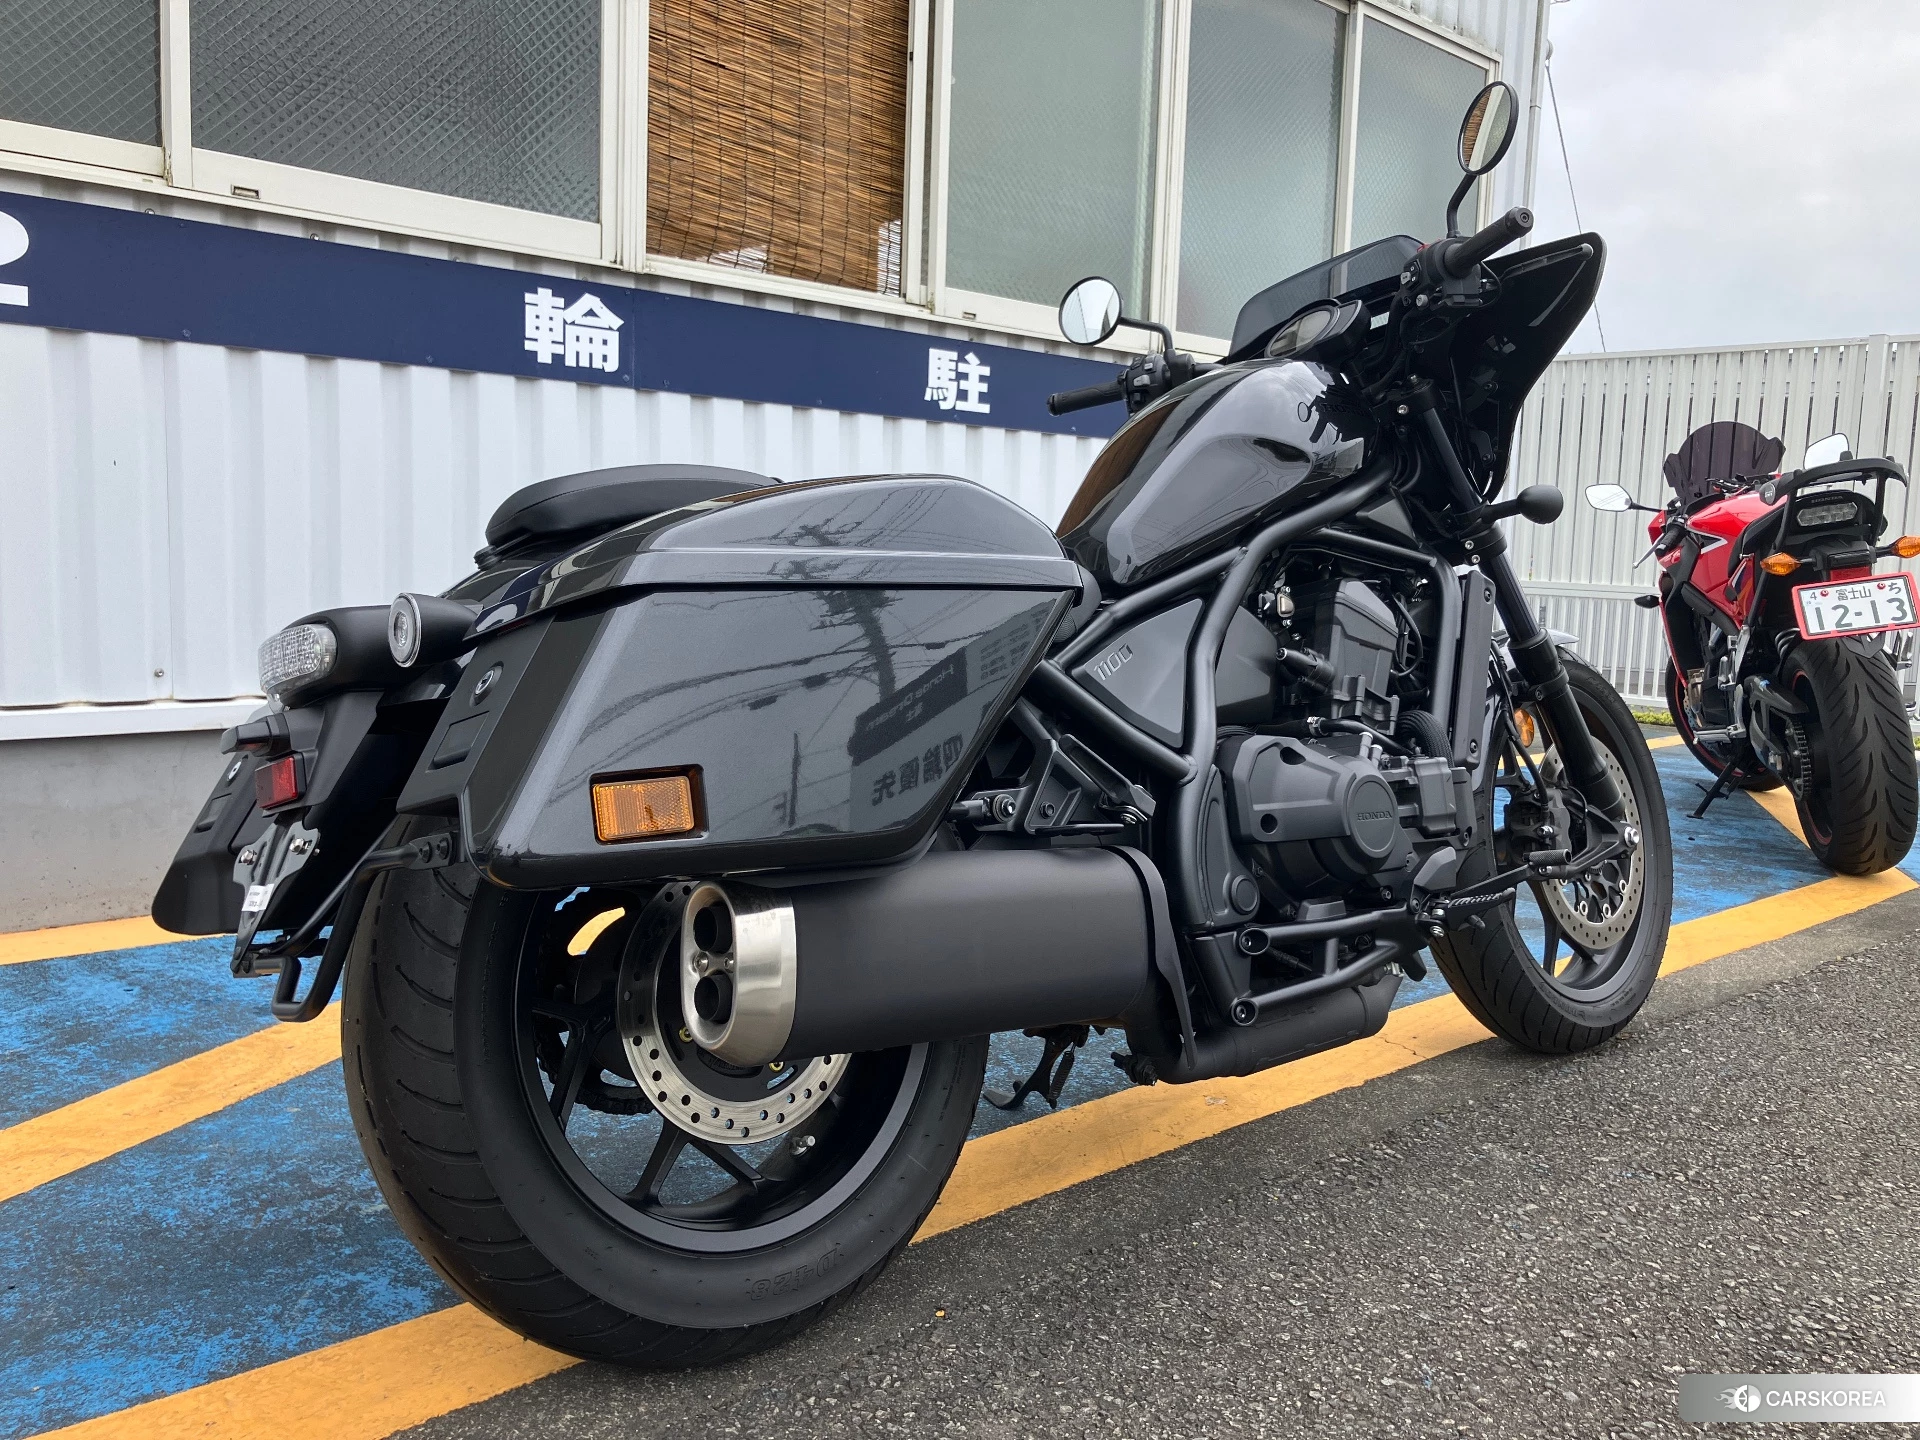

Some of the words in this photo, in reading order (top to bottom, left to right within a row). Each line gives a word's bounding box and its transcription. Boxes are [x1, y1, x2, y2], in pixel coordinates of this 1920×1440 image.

[524, 287, 625, 372] 輪
[924, 348, 991, 413] 駐
[1810, 591, 1817, 600] 4
[1836, 586, 1871, 601] 富士山
[1888, 582, 1901, 594] ち
[1815, 598, 1908, 630] 12-13
[1094, 643, 1133, 680] 1100
[1357, 811, 1392, 821] HONDA
